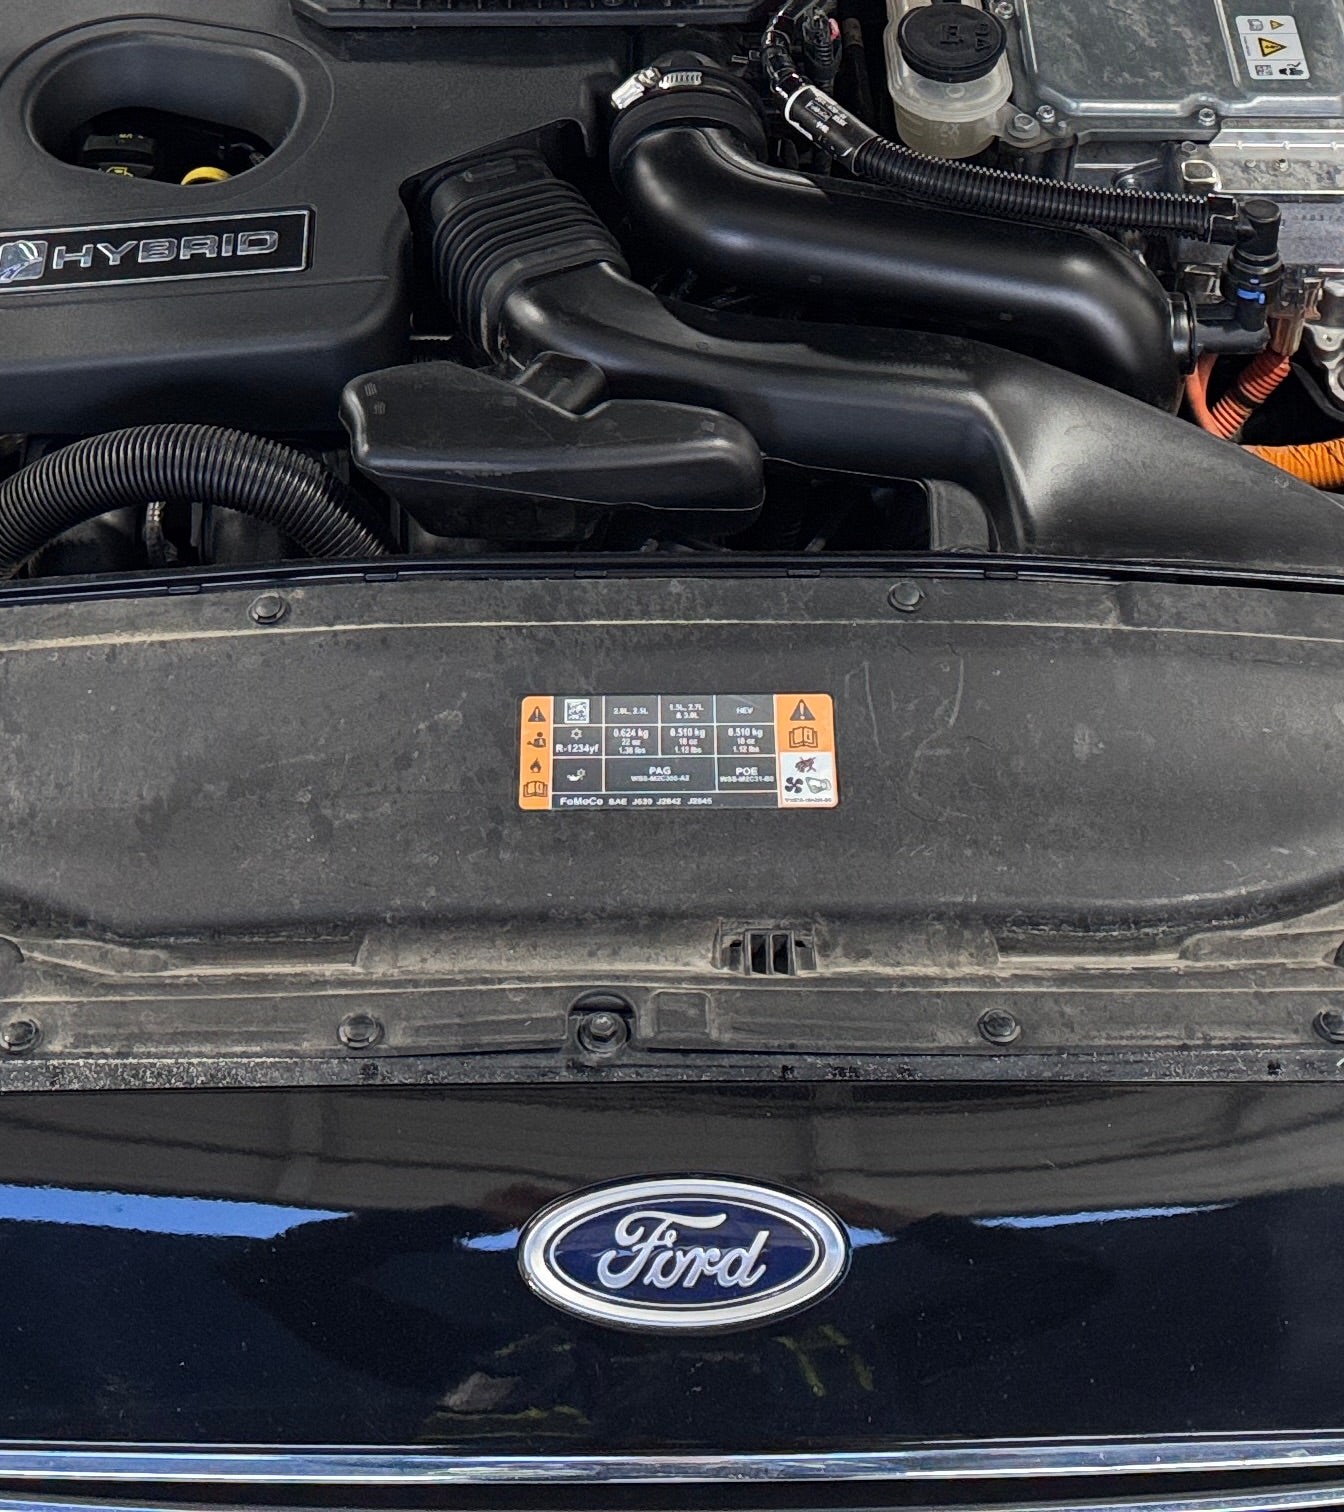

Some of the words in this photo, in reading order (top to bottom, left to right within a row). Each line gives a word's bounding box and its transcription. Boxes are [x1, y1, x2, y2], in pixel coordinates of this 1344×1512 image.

[52, 230, 280, 270] HYBRID
[613, 728, 636, 738] 0.624
[637, 728, 649, 740] kg
[669, 727, 693, 737] 0.510
[694, 727, 706, 739] kg
[727, 727, 751, 737] 0.510
[751, 727, 764, 739] kg
[621, 738, 630, 746] 22
[555, 743, 600, 755] R-1234yf
[649, 766, 672, 775] PAG
[736, 766, 758, 776] POE
[559, 796, 604, 806] FoMoCo
[608, 797, 628, 806] SAE
[597, 1210, 770, 1289] Ford
